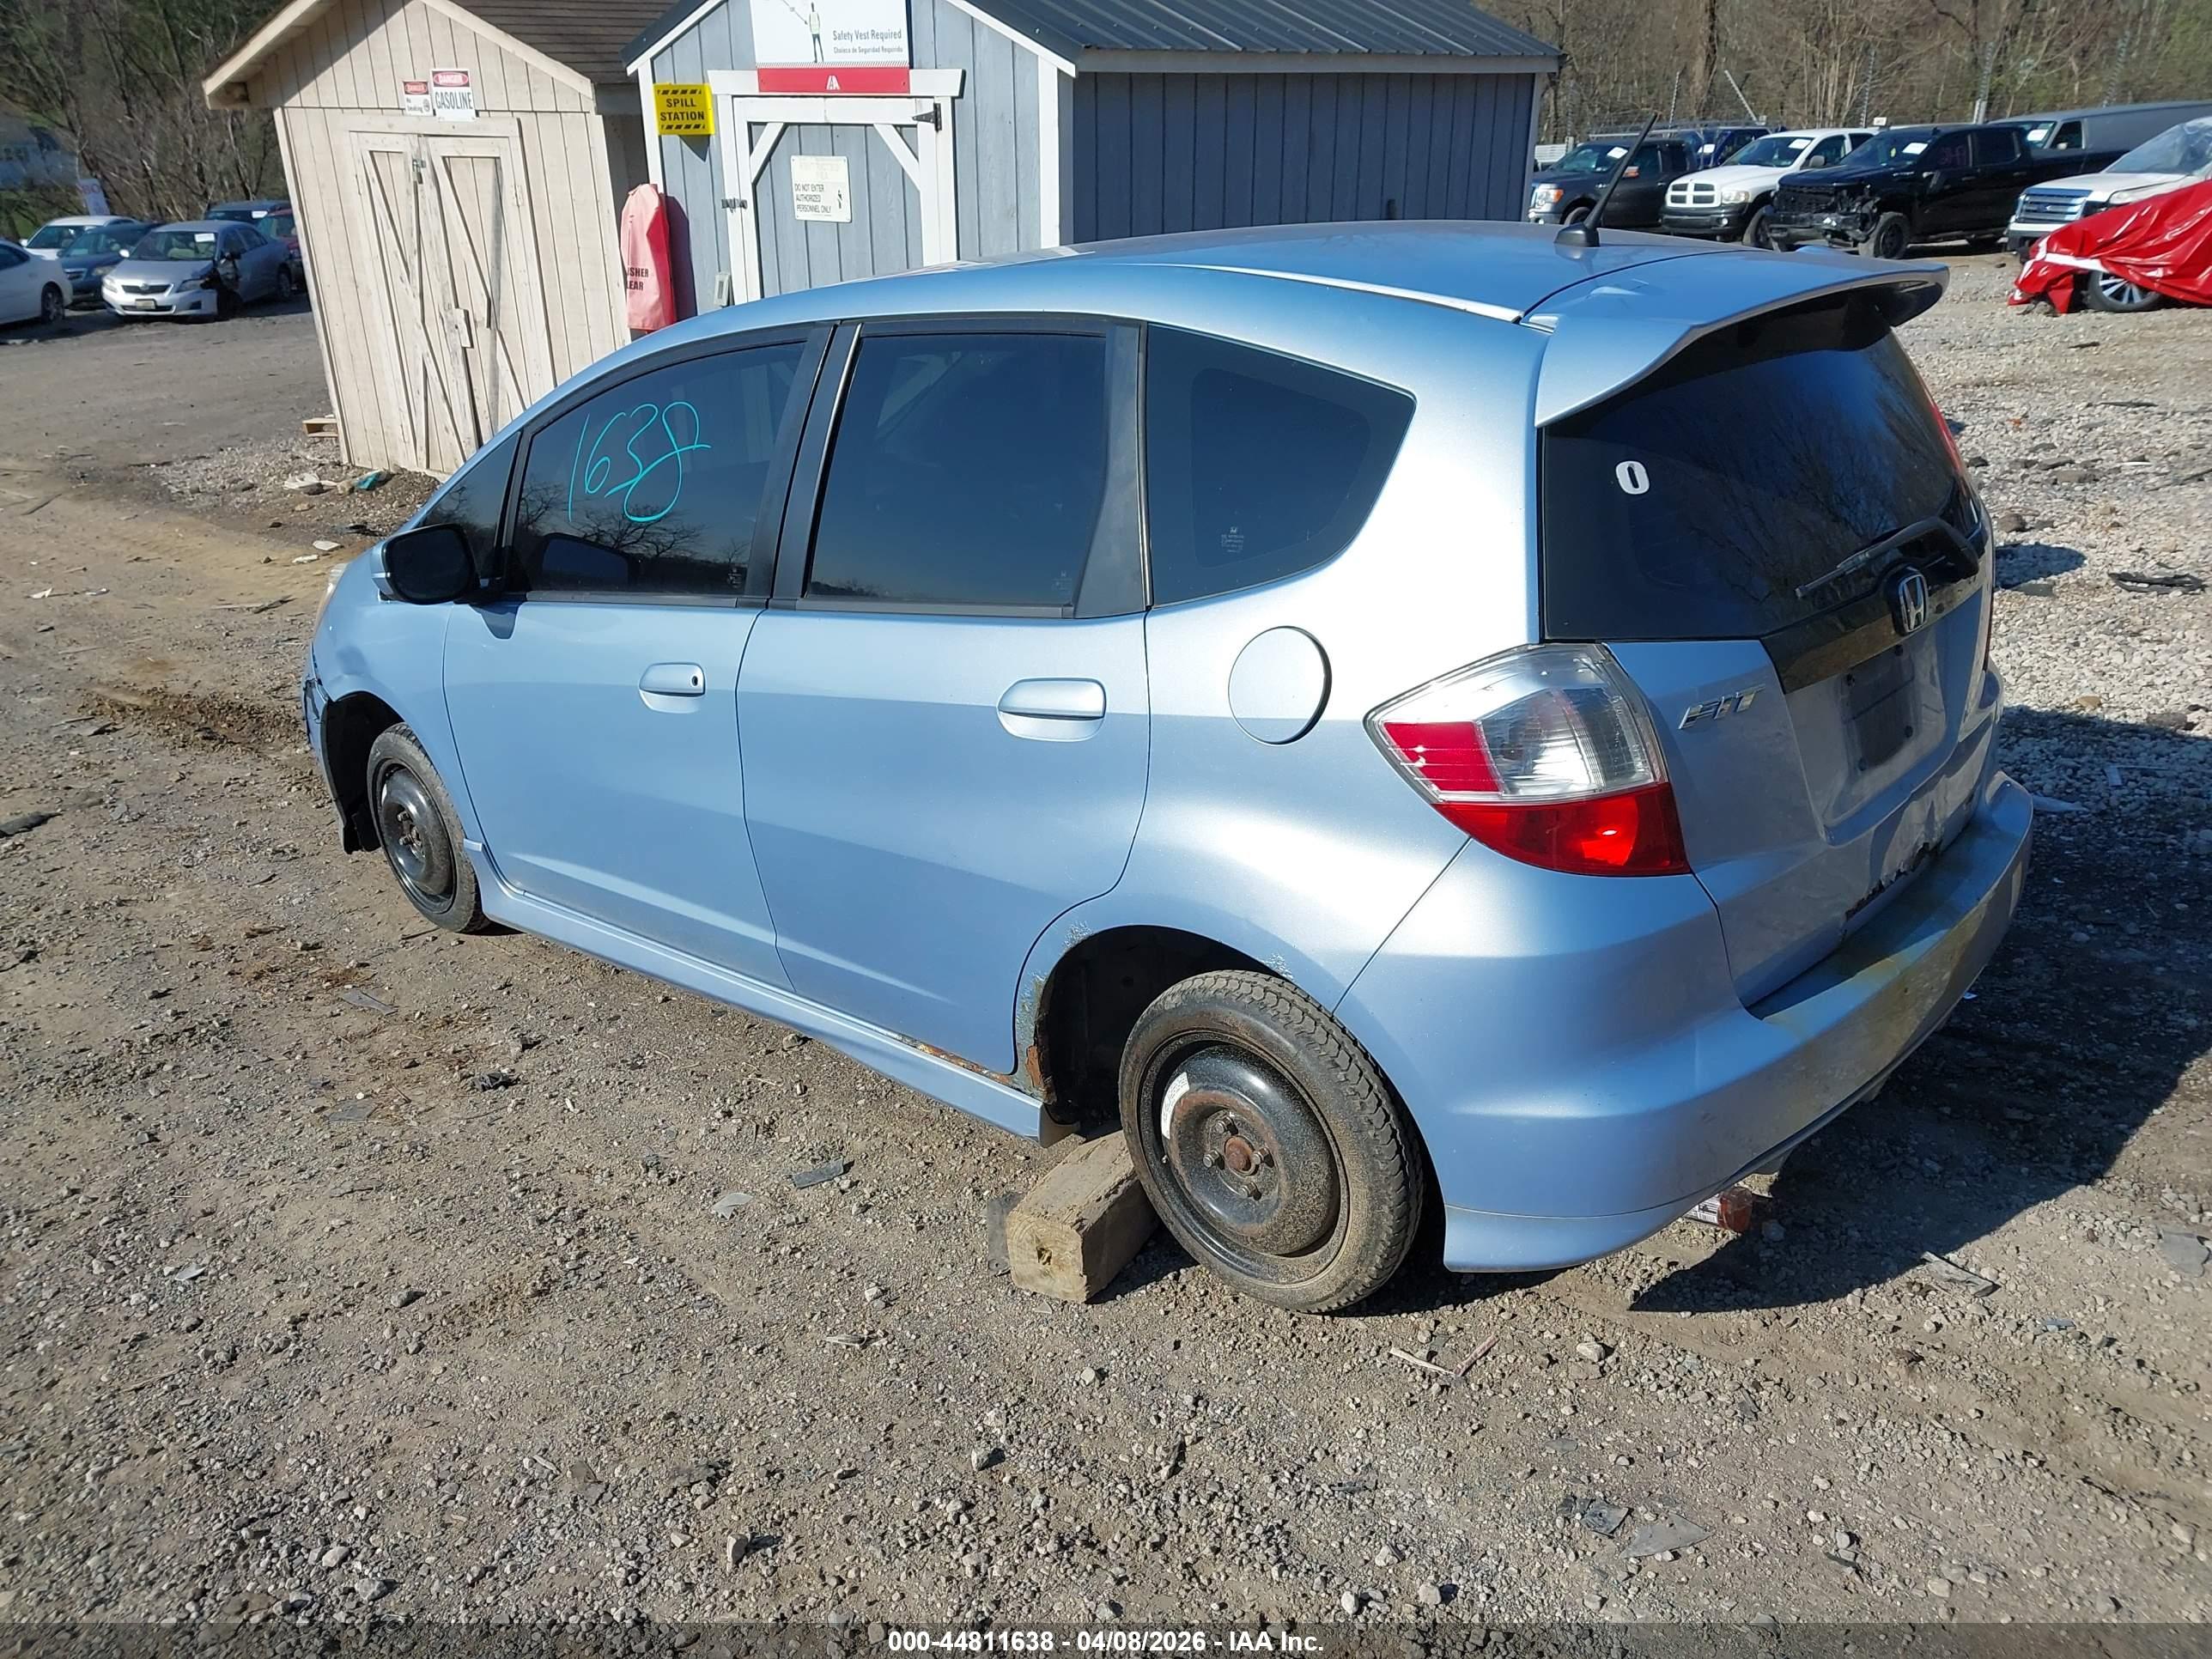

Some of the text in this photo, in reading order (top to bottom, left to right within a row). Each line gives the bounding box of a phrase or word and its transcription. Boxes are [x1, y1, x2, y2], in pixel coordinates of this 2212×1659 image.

[833, 28, 902, 42] Safety Vest Required
[435, 92, 472, 109] GASOLINE
[665, 97, 696, 108] SPILL
[659, 111, 705, 121] STATION
[811, 184, 824, 192] ENTER
[569, 401, 712, 523] 1638
[1678, 684, 1766, 730] FIT
